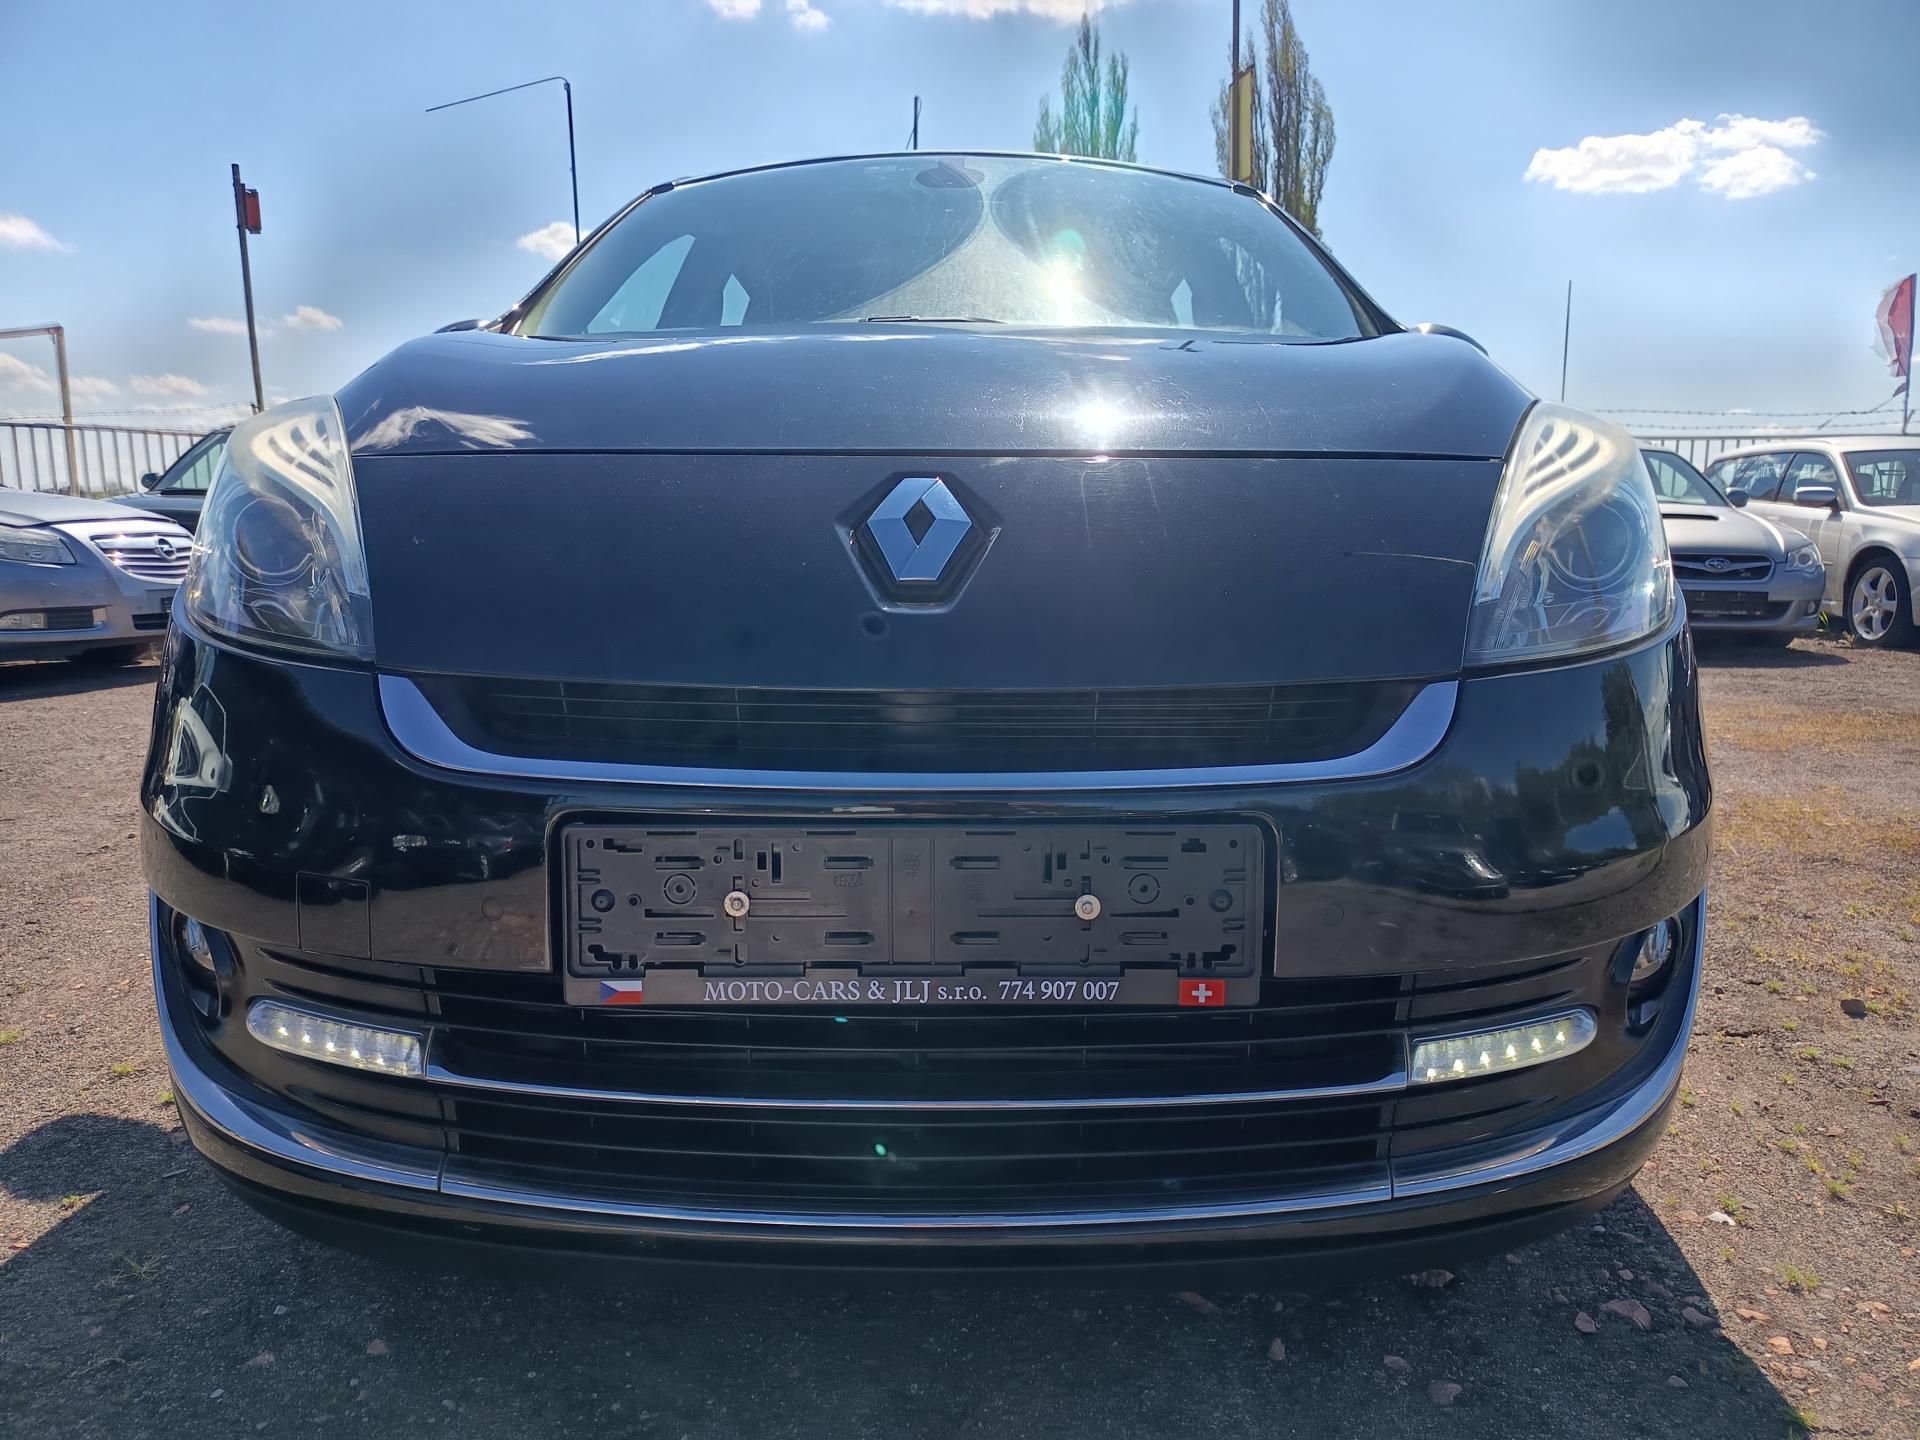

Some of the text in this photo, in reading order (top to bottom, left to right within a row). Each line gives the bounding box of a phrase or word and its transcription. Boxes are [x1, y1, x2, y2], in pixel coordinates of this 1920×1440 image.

[703, 980, 1119, 1003] MOTO-CARS & JLJ s.r.o. 774 907 007
